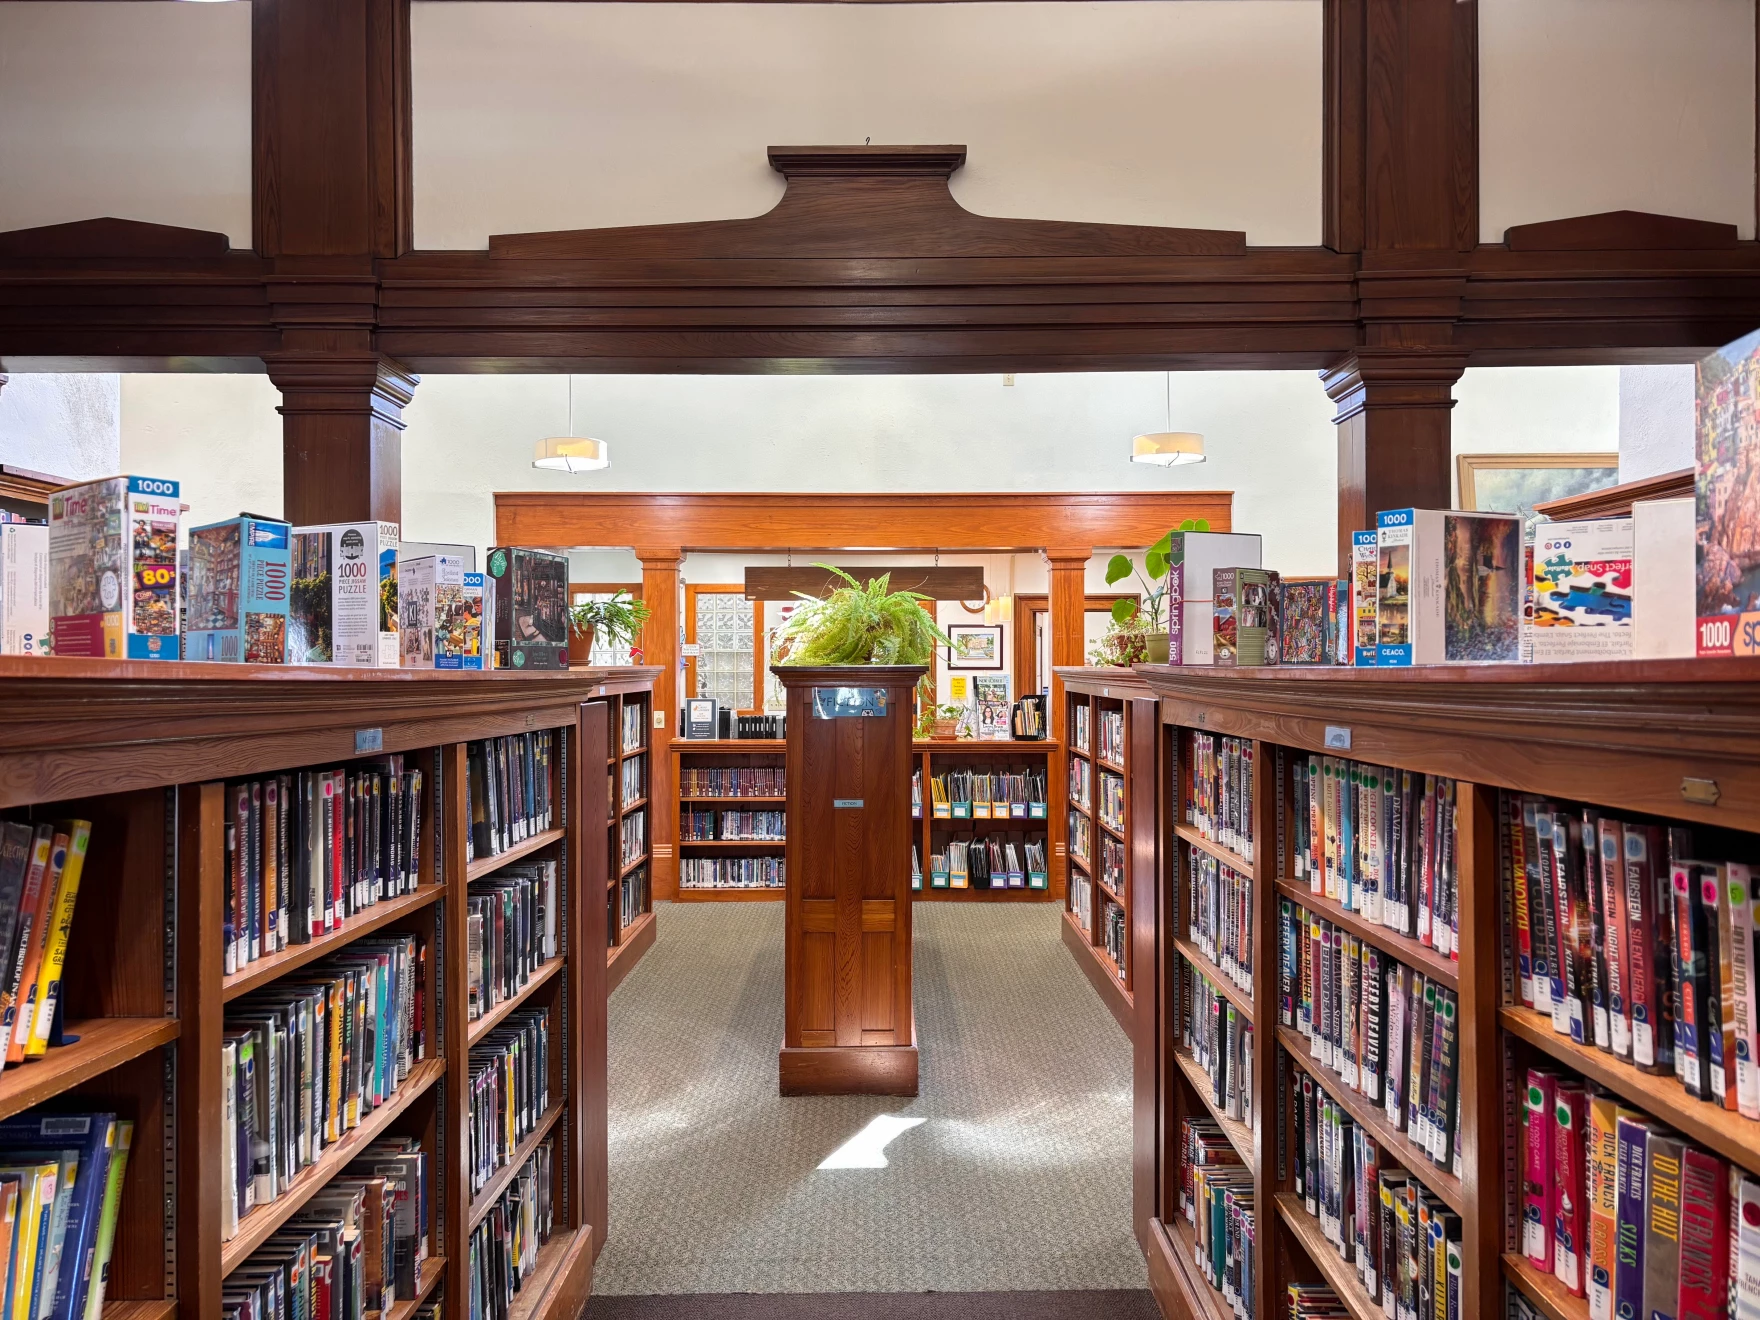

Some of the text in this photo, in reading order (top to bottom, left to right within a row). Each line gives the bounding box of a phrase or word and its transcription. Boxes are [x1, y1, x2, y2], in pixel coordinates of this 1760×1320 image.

[64, 496, 88, 517] Time
[137, 479, 174, 495] 1000
[150, 504, 177, 517] Time
[1383, 513, 1407, 525] 1000
[248, 522, 256, 547] EMPIRE
[379, 524, 398, 537] 1000
[1358, 534, 1377, 544] 100
[256, 559, 264, 601] PIECE PUZZLE
[264, 560, 287, 601] 1000
[337, 562, 367, 578] 1000
[338, 584, 367, 594] PUZZLE
[464, 576, 481, 584] 000
[1222, 572, 1235, 580] 1000
[1170, 570, 1182, 635] springbok
[221, 635, 238, 657] 1000
[1169, 641, 1178, 661] 500
[1574, 631, 1598, 640] Perfect
[1699, 620, 1731, 648] 1000
[1369, 816, 1377, 850] COOKIE
[1392, 796, 1401, 841] DEAVER
[1540, 846, 1552, 896] JEOPARDY
[1513, 854, 1529, 931] EVANOVICH
[1605, 863, 1620, 960] FAIRSTEIN NIGHT
[1627, 865, 1643, 922] FAIRSTEIN
[1545, 907, 1556, 939] LINDA
[1555, 862, 1576, 991] FAIRSTEIN KILLER
[13, 925, 32, 982] ARCHBISHOP
[1281, 913, 1291, 993] EFFERY DEAVER
[1630, 927, 1646, 966] SILENT
[11, 981, 19, 993] IN
[1303, 958, 1312, 998] DEAVER
[1322, 946, 1331, 1033] EFFERY DEAVER
[1350, 959, 1359, 1003] DEAVER
[1333, 1008, 1341, 1036] SLEEPIN
[1368, 973, 1380, 1062] EFFERY DEAVER
[1734, 999, 1749, 1037] STUFF
[1180, 1141, 1188, 1169] CRAIS
[1562, 1149, 1570, 1178] VELVET
[1602, 1131, 1617, 1211] DICK FRANCIS
[1619, 1139, 1628, 1195] FELIX FRANCIS
[1630, 1144, 1643, 1201] DICK FRANCIS
[1651, 1152, 1680, 1243] TO THE HILT
[1593, 1220, 1608, 1265] CROSS
[1620, 1220, 1637, 1268] SILKS
[1681, 1163, 1716, 1296] DICK FRANCIS
